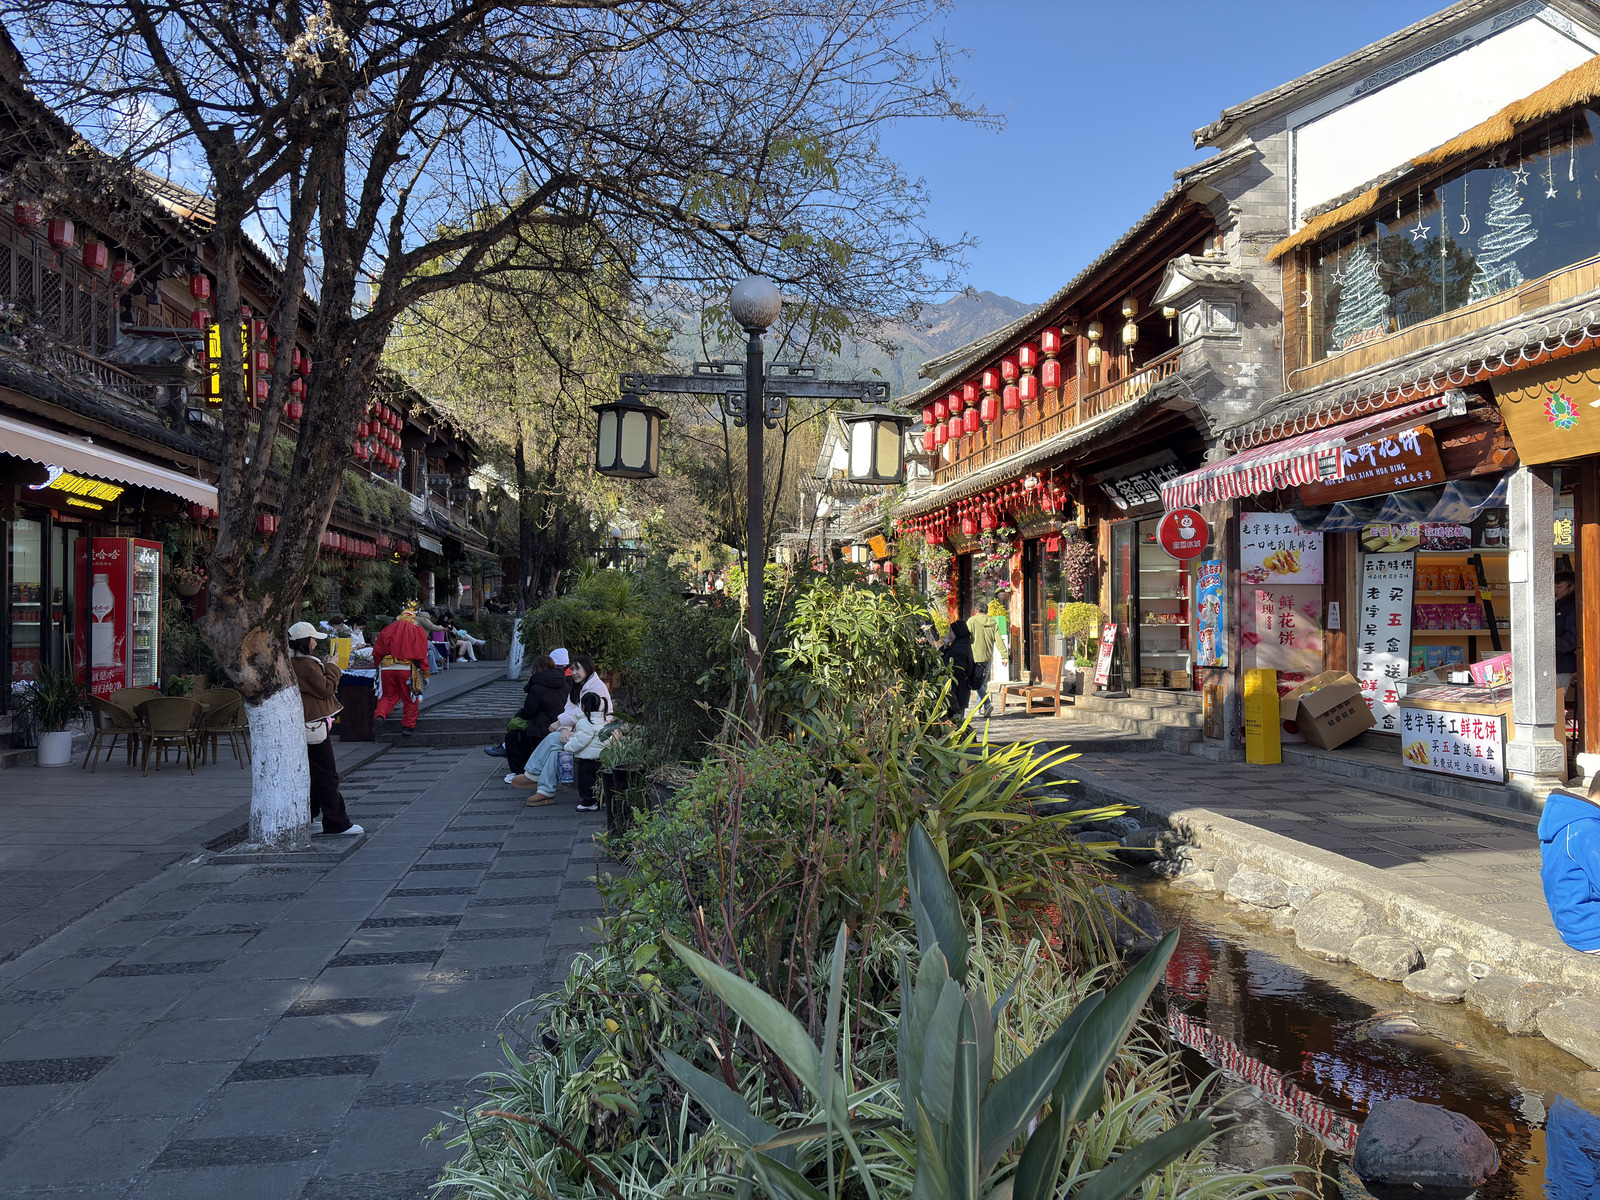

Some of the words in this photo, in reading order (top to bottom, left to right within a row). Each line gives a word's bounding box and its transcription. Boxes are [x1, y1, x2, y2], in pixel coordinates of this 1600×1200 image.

[1360, 470, 1374, 479] XIAN
[1376, 467, 1388, 476] HUA
[1390, 462, 1406, 473] BING
[1243, 524, 1321, 536] 老字号手工鲜
[1370, 527, 1418, 537] 云南十八怪
[1173, 540, 1201, 549] 蜜雪冰城
[1247, 540, 1317, 552] 一口吃到真鲜花
[1366, 559, 1413, 571] 云南特供
[1261, 591, 1275, 615] 玫瑰
[1278, 595, 1295, 646] 鲜花饼
[1382, 587, 1404, 730] 买五盒送五盒
[1404, 712, 1497, 741] 老字号手工鲜花饼
[1432, 740, 1495, 760] 买五盒送五盒
[1432, 757, 1461, 770] 免费试吃
[1465, 762, 1496, 776] 全国包邮
